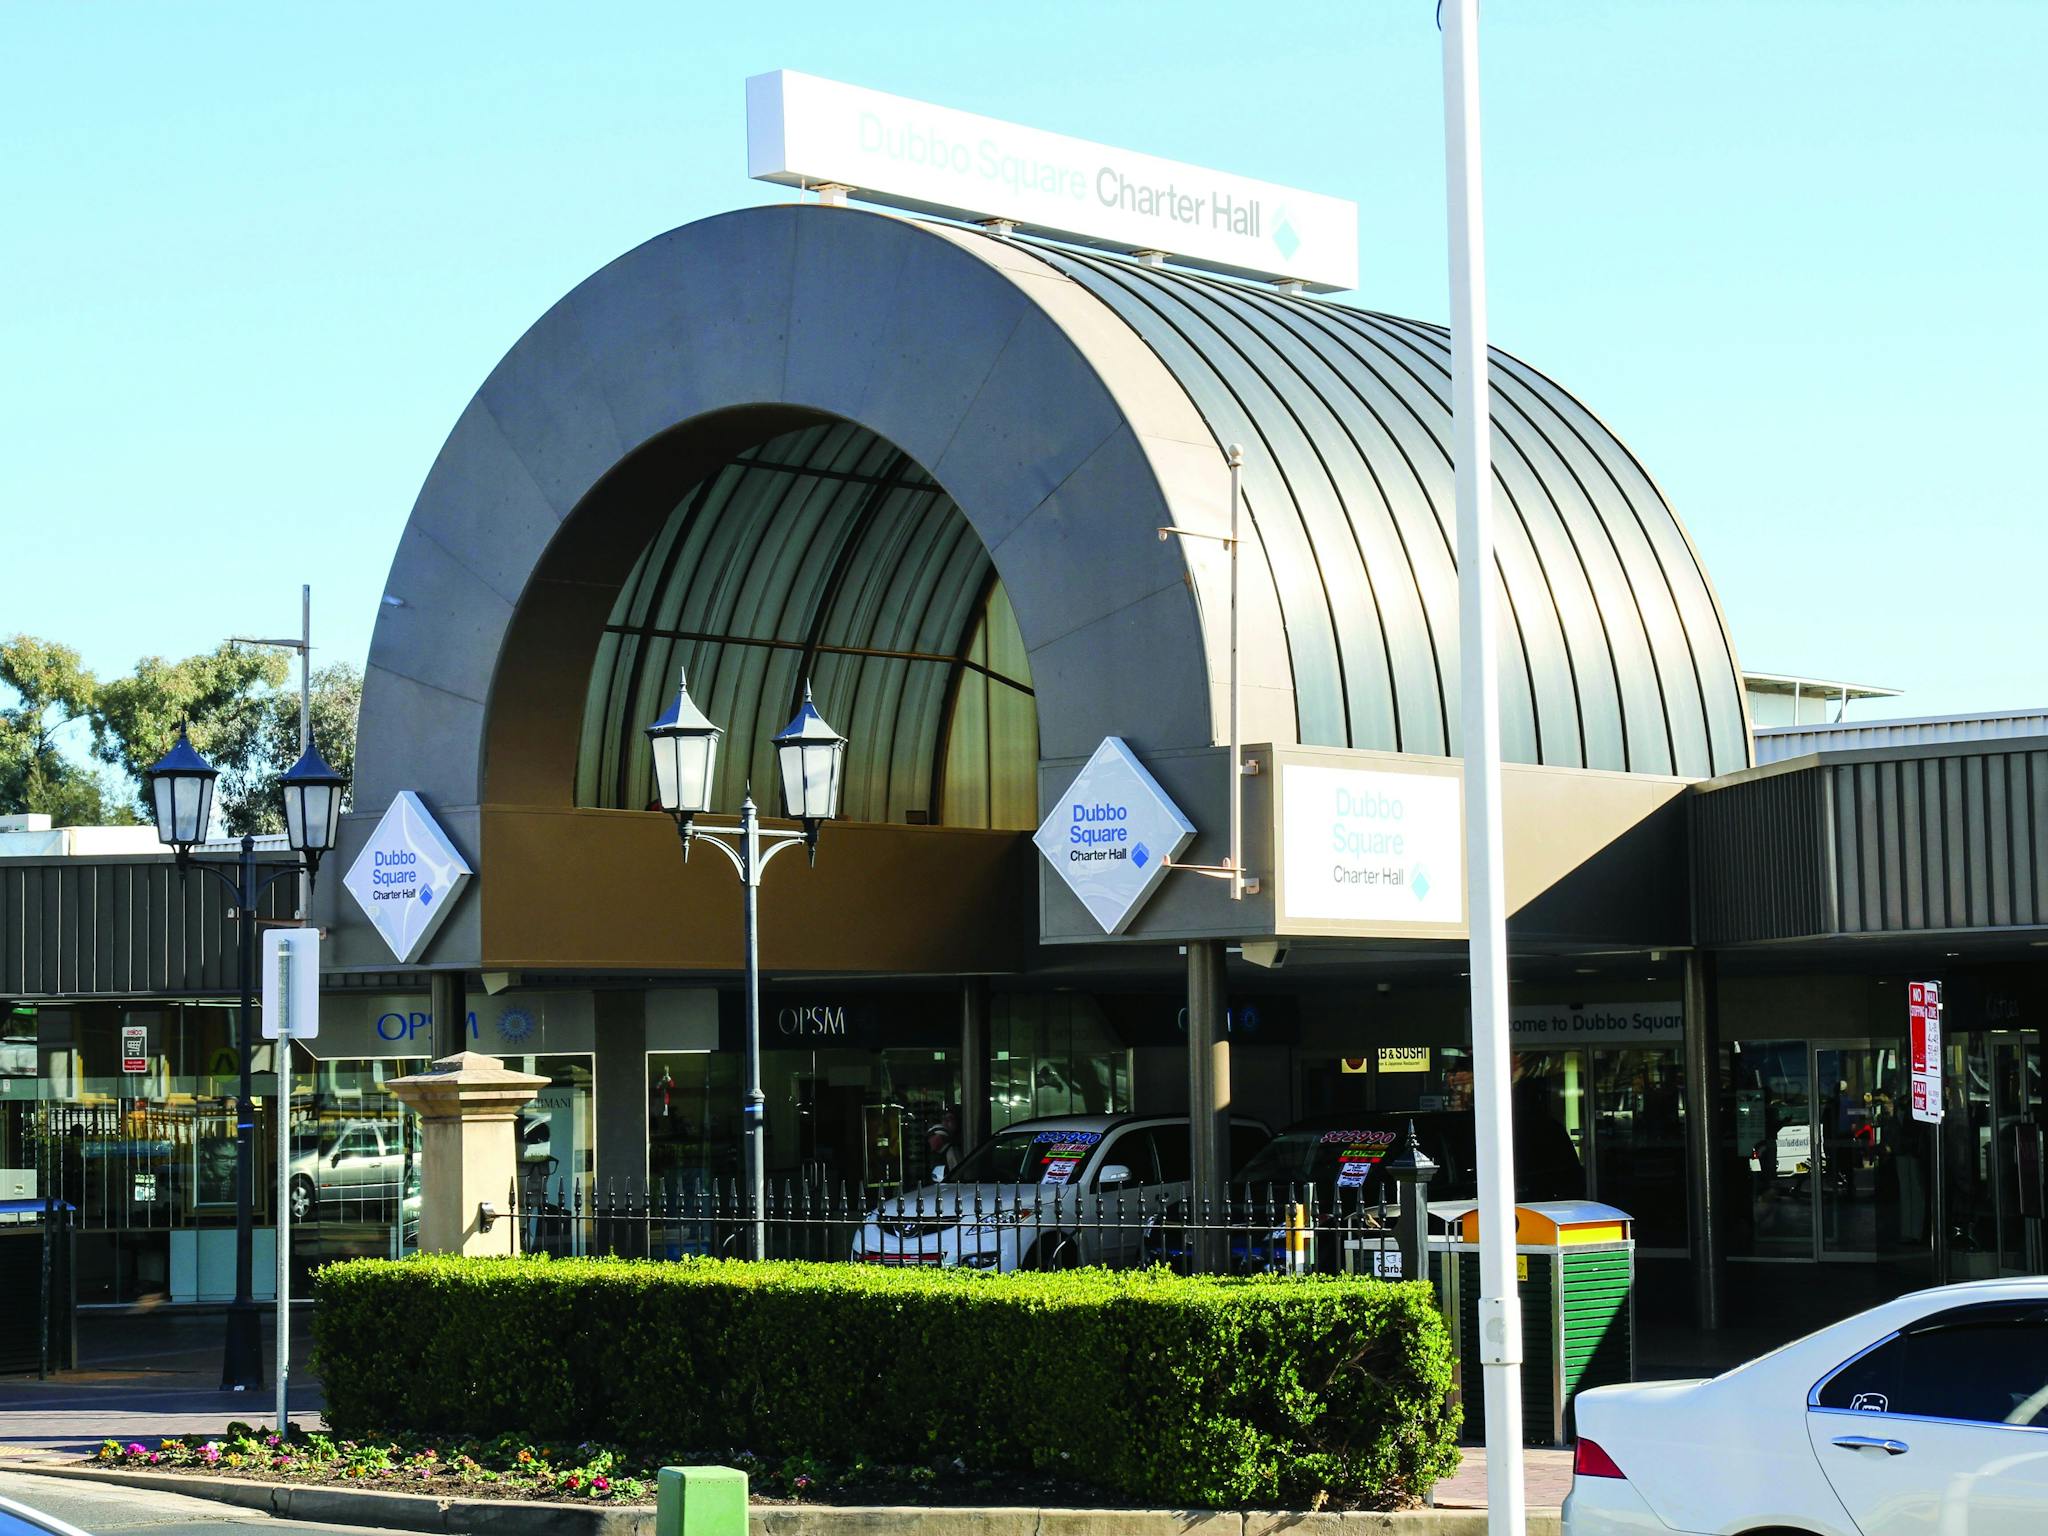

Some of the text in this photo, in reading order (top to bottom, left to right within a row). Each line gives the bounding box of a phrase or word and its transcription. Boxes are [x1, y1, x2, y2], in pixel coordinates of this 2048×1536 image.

[859, 110, 1260, 238] Dubbo Square Charter Hall
[1073, 803, 1127, 822] Dubbo
[1335, 786, 1404, 820] Dubbo
[1070, 825, 1128, 847] Square
[1332, 822, 1405, 861] Square
[375, 850, 417, 867] Dubbo
[1070, 847, 1127, 862] Charter Hall
[373, 869, 417, 887] Square
[1333, 864, 1404, 886] Charter Hall
[373, 888, 416, 901] Charter Hall
[1912, 987, 1922, 1002] NO
[377, 1011, 479, 1041] OP
[778, 1006, 845, 1035] OPSM
[1509, 1012, 1683, 1034] ome to Dubbo Squar
[1396, 1047, 1427, 1059] SUSHI
[1913, 1082, 1926, 1094] TAXI
